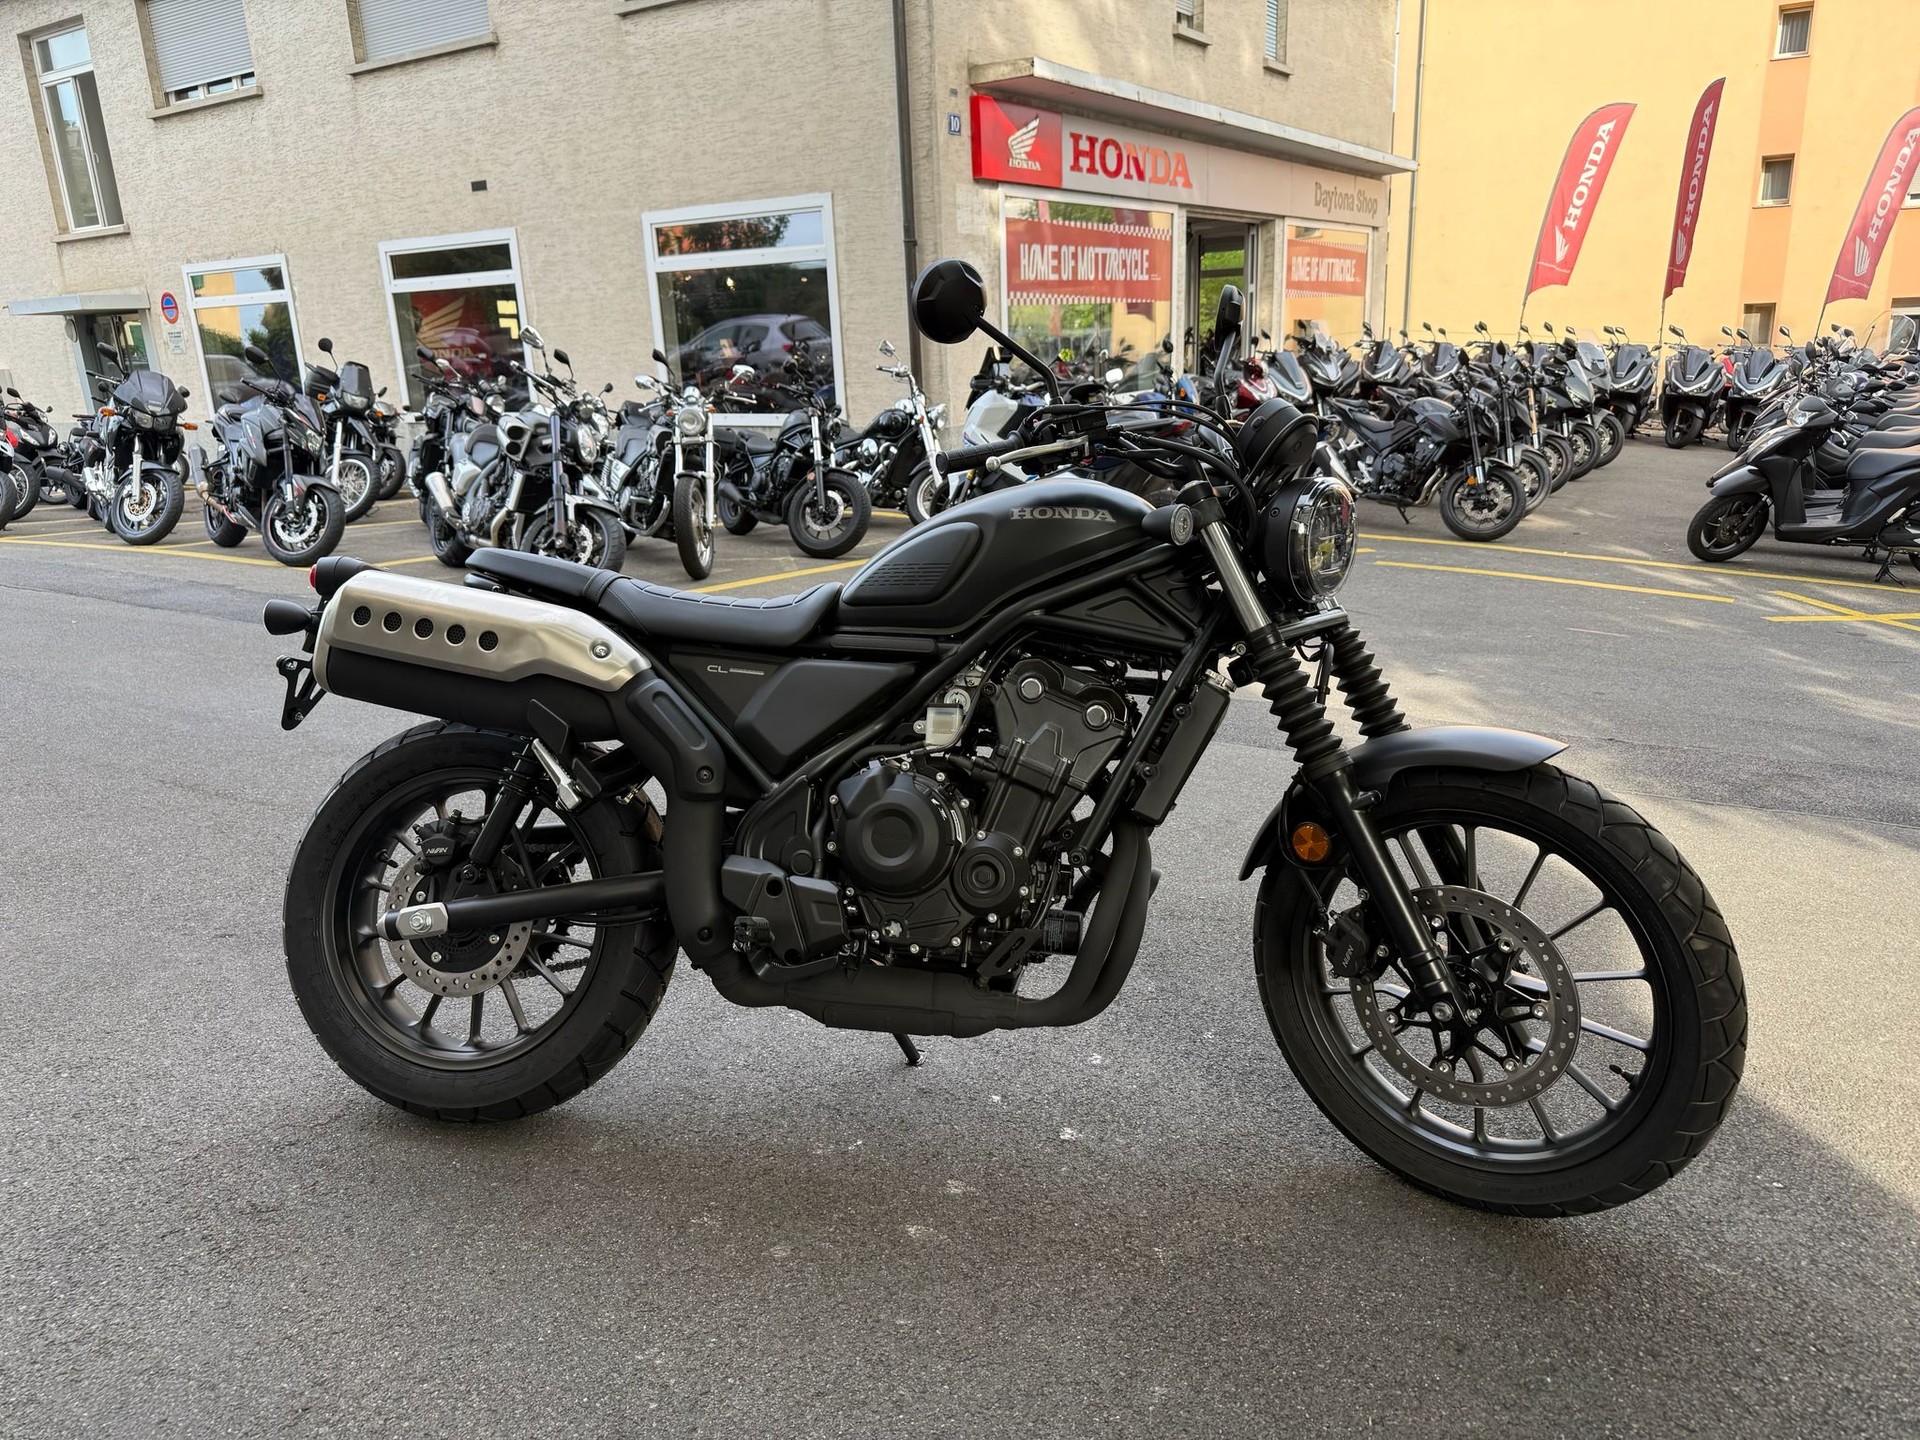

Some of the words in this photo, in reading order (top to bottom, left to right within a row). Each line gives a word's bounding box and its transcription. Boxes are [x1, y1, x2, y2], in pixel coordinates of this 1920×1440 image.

[950, 115, 960, 132] 10
[1008, 157, 1042, 171] HONDA
[1069, 131, 1193, 189] HONDA
[1562, 119, 1617, 231] HONDA
[1684, 100, 1713, 227] HONDA
[1314, 181, 1354, 213] Daytona
[1356, 189, 1378, 219] Shop
[1867, 127, 1920, 243] HONDA
[1061, 245, 1076, 281] OF
[1010, 507, 1116, 523] HONDA
[707, 665, 728, 673] CL
